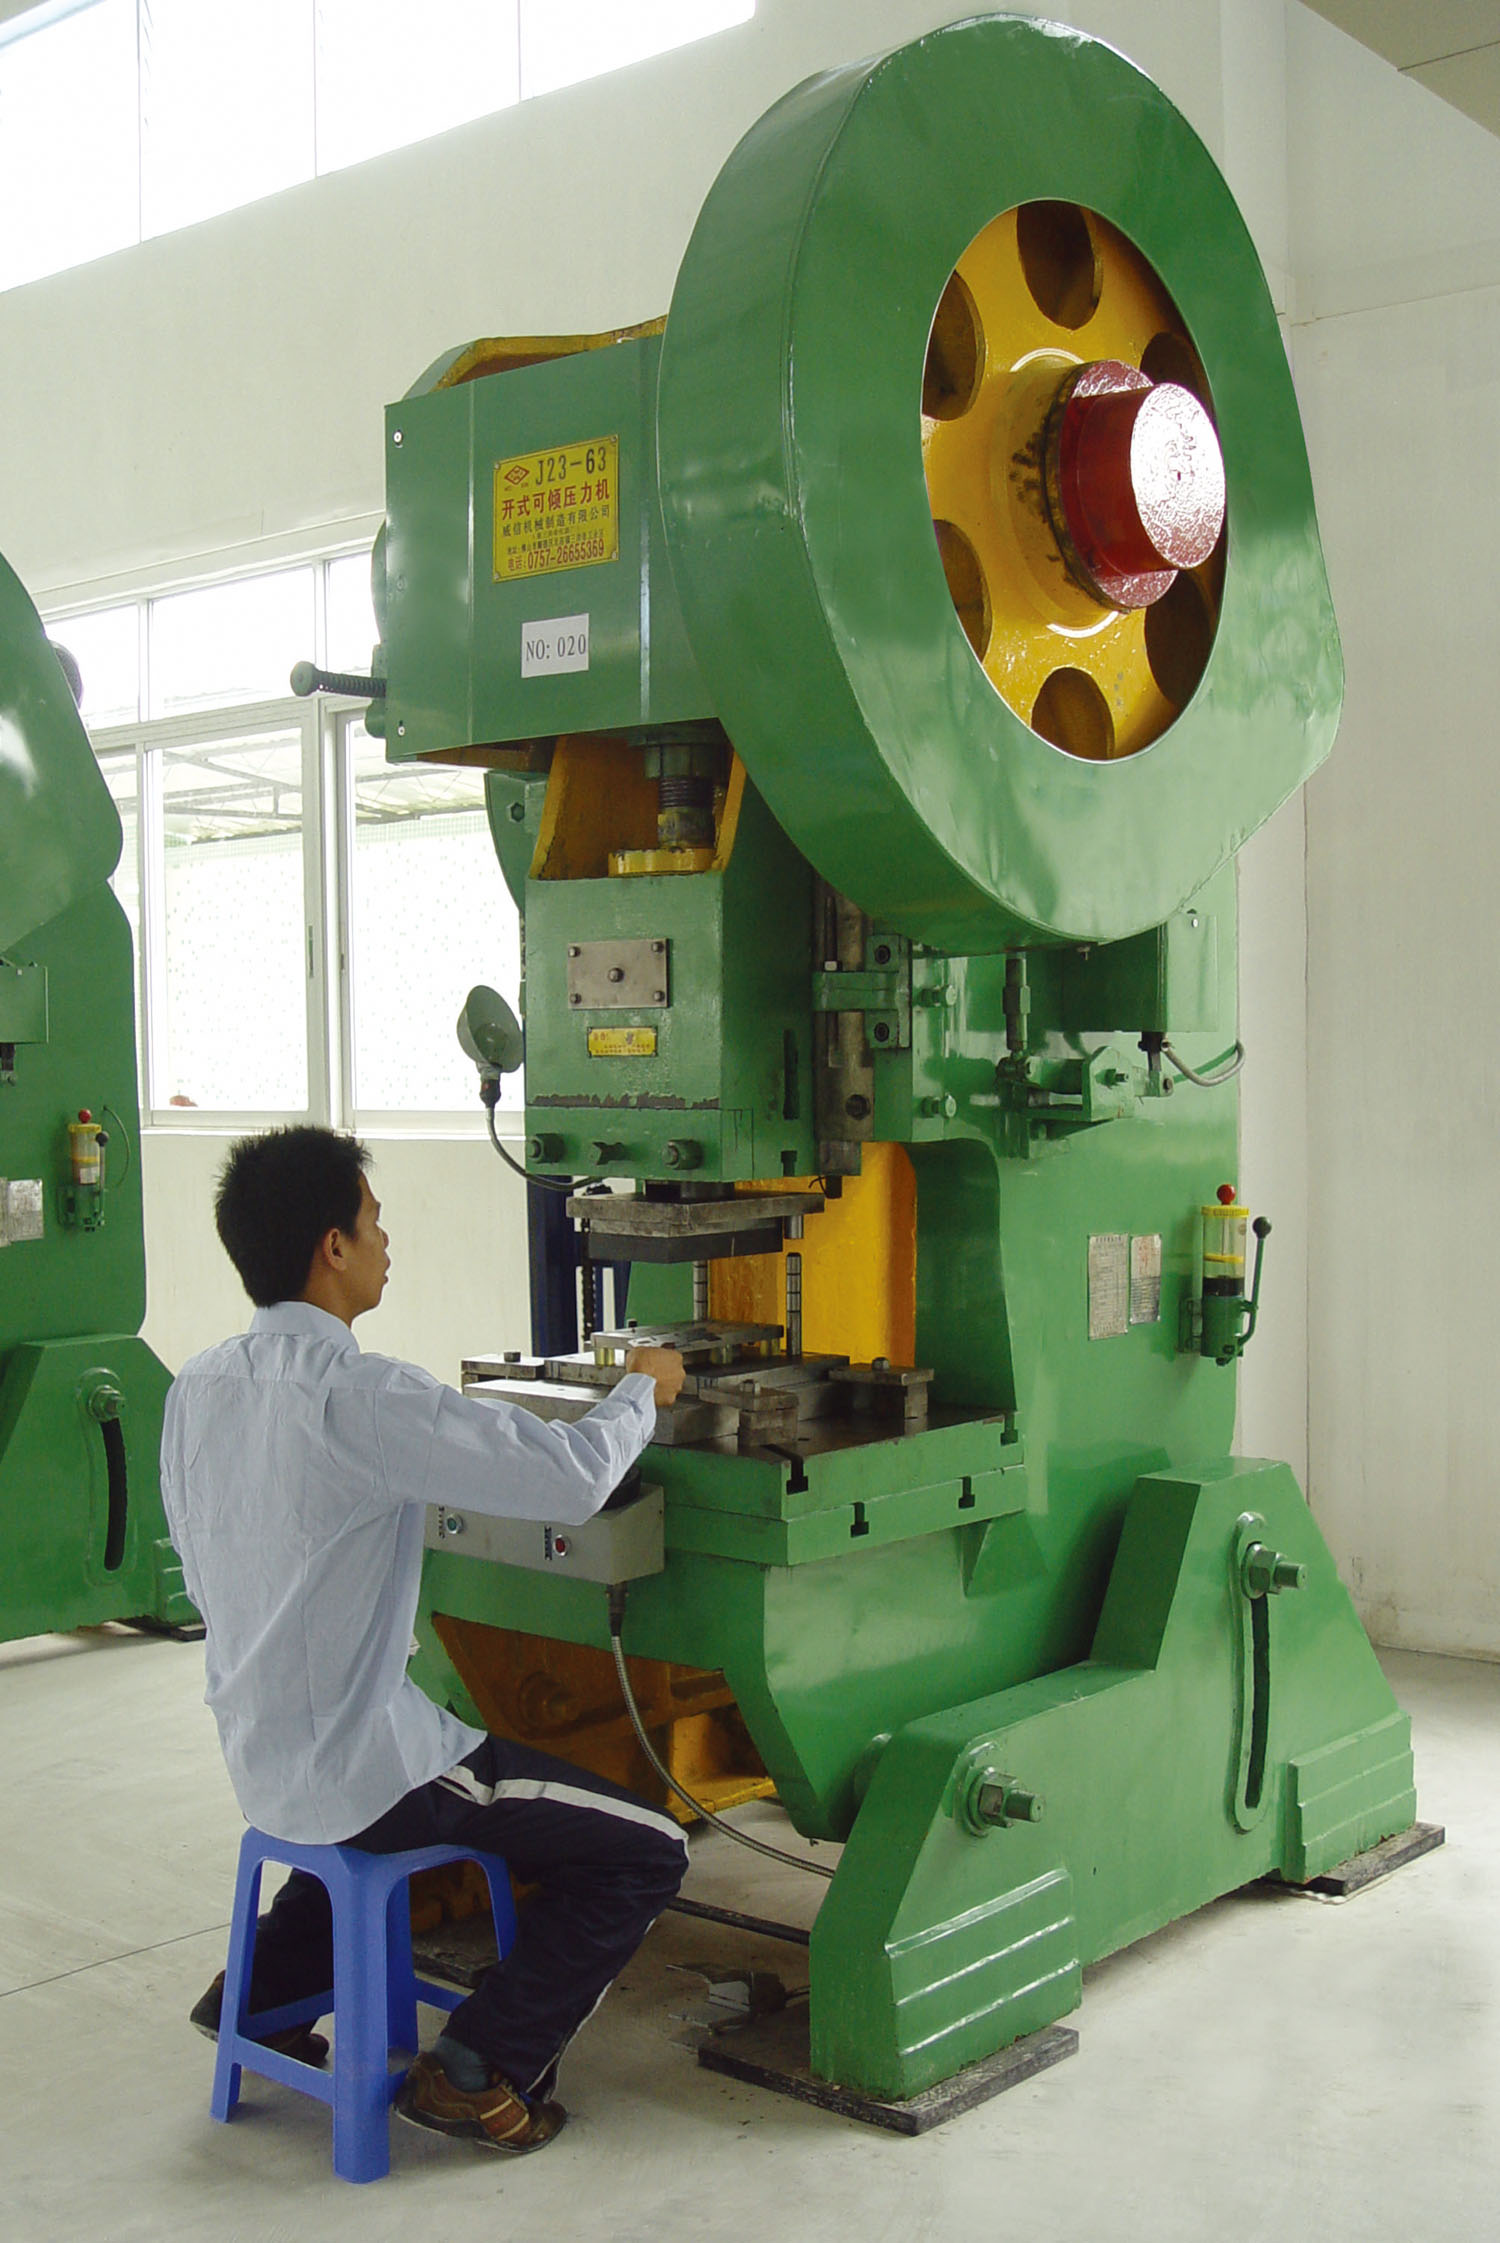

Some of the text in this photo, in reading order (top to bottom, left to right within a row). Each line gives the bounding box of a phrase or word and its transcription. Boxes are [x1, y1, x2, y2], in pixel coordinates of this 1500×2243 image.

[535, 446, 606, 486] J23-63
[502, 478, 610, 521] 开式可倾压力机
